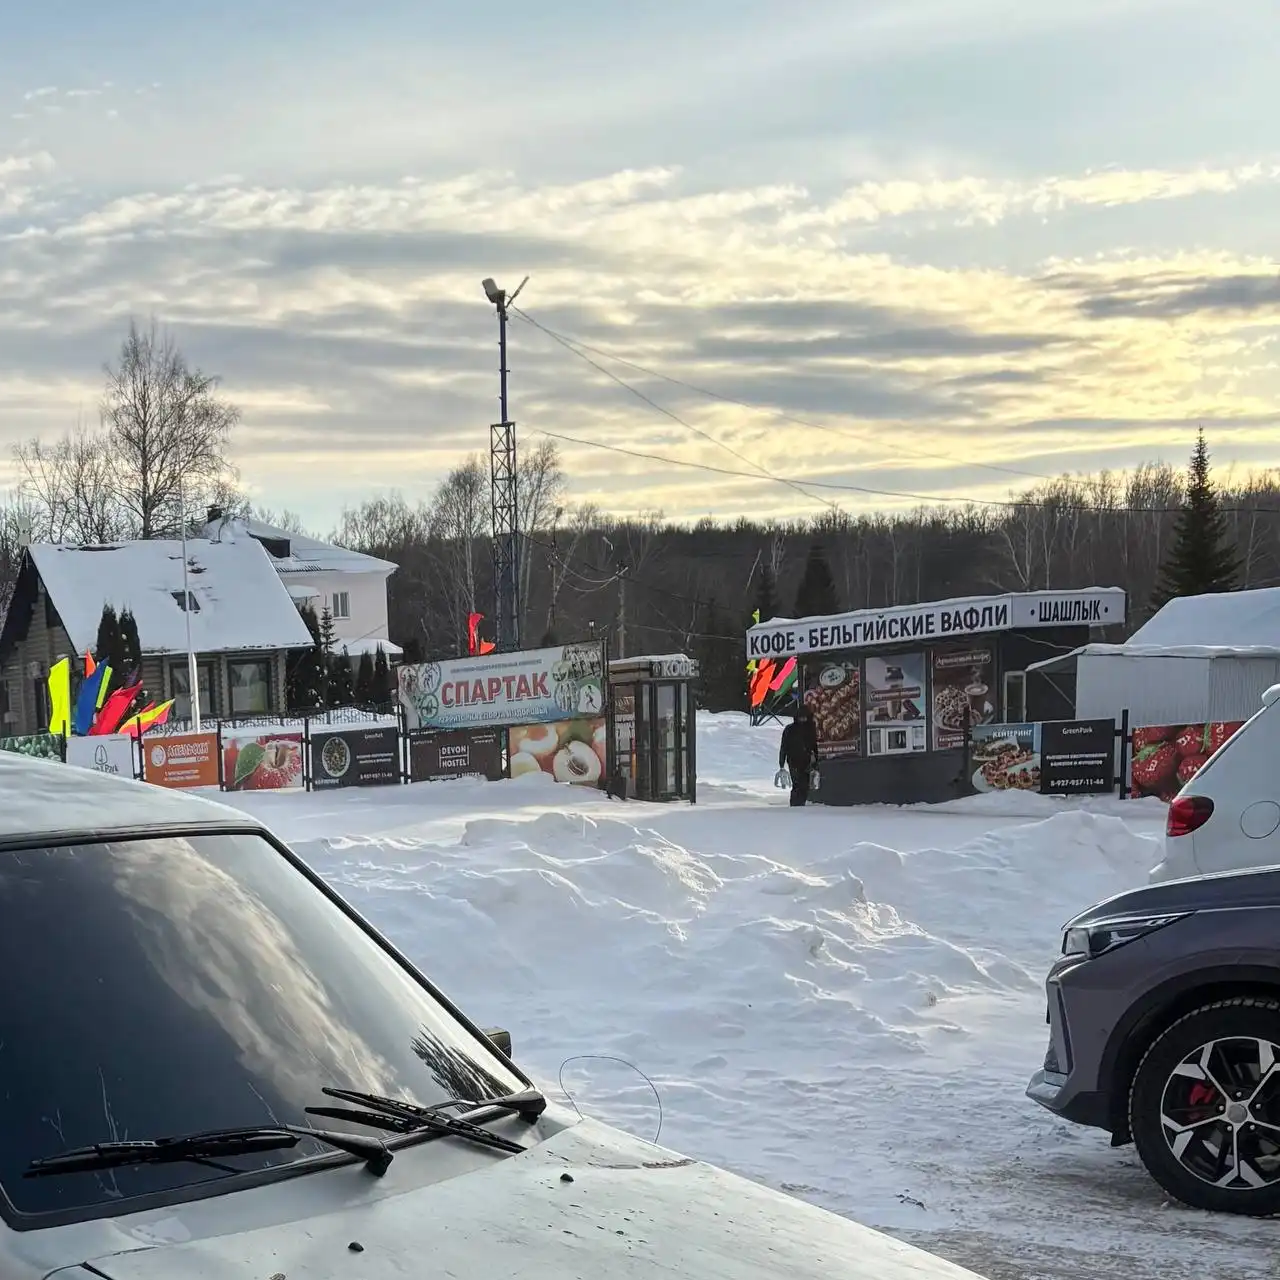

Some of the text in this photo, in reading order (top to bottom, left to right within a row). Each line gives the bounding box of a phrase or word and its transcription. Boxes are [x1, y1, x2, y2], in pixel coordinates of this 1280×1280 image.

[1039, 600, 1100, 622] ШАШЛЫК
[750, 604, 1007, 655] КОФЕ БЕЛЬГИЙСКИЕ ВАФЛИ
[661, 659, 699, 677] КОФЕ
[440, 671, 551, 708] СПАРТАК
[441, 746, 466, 755] DEVON
[442, 758, 466, 768] HOSTEL
